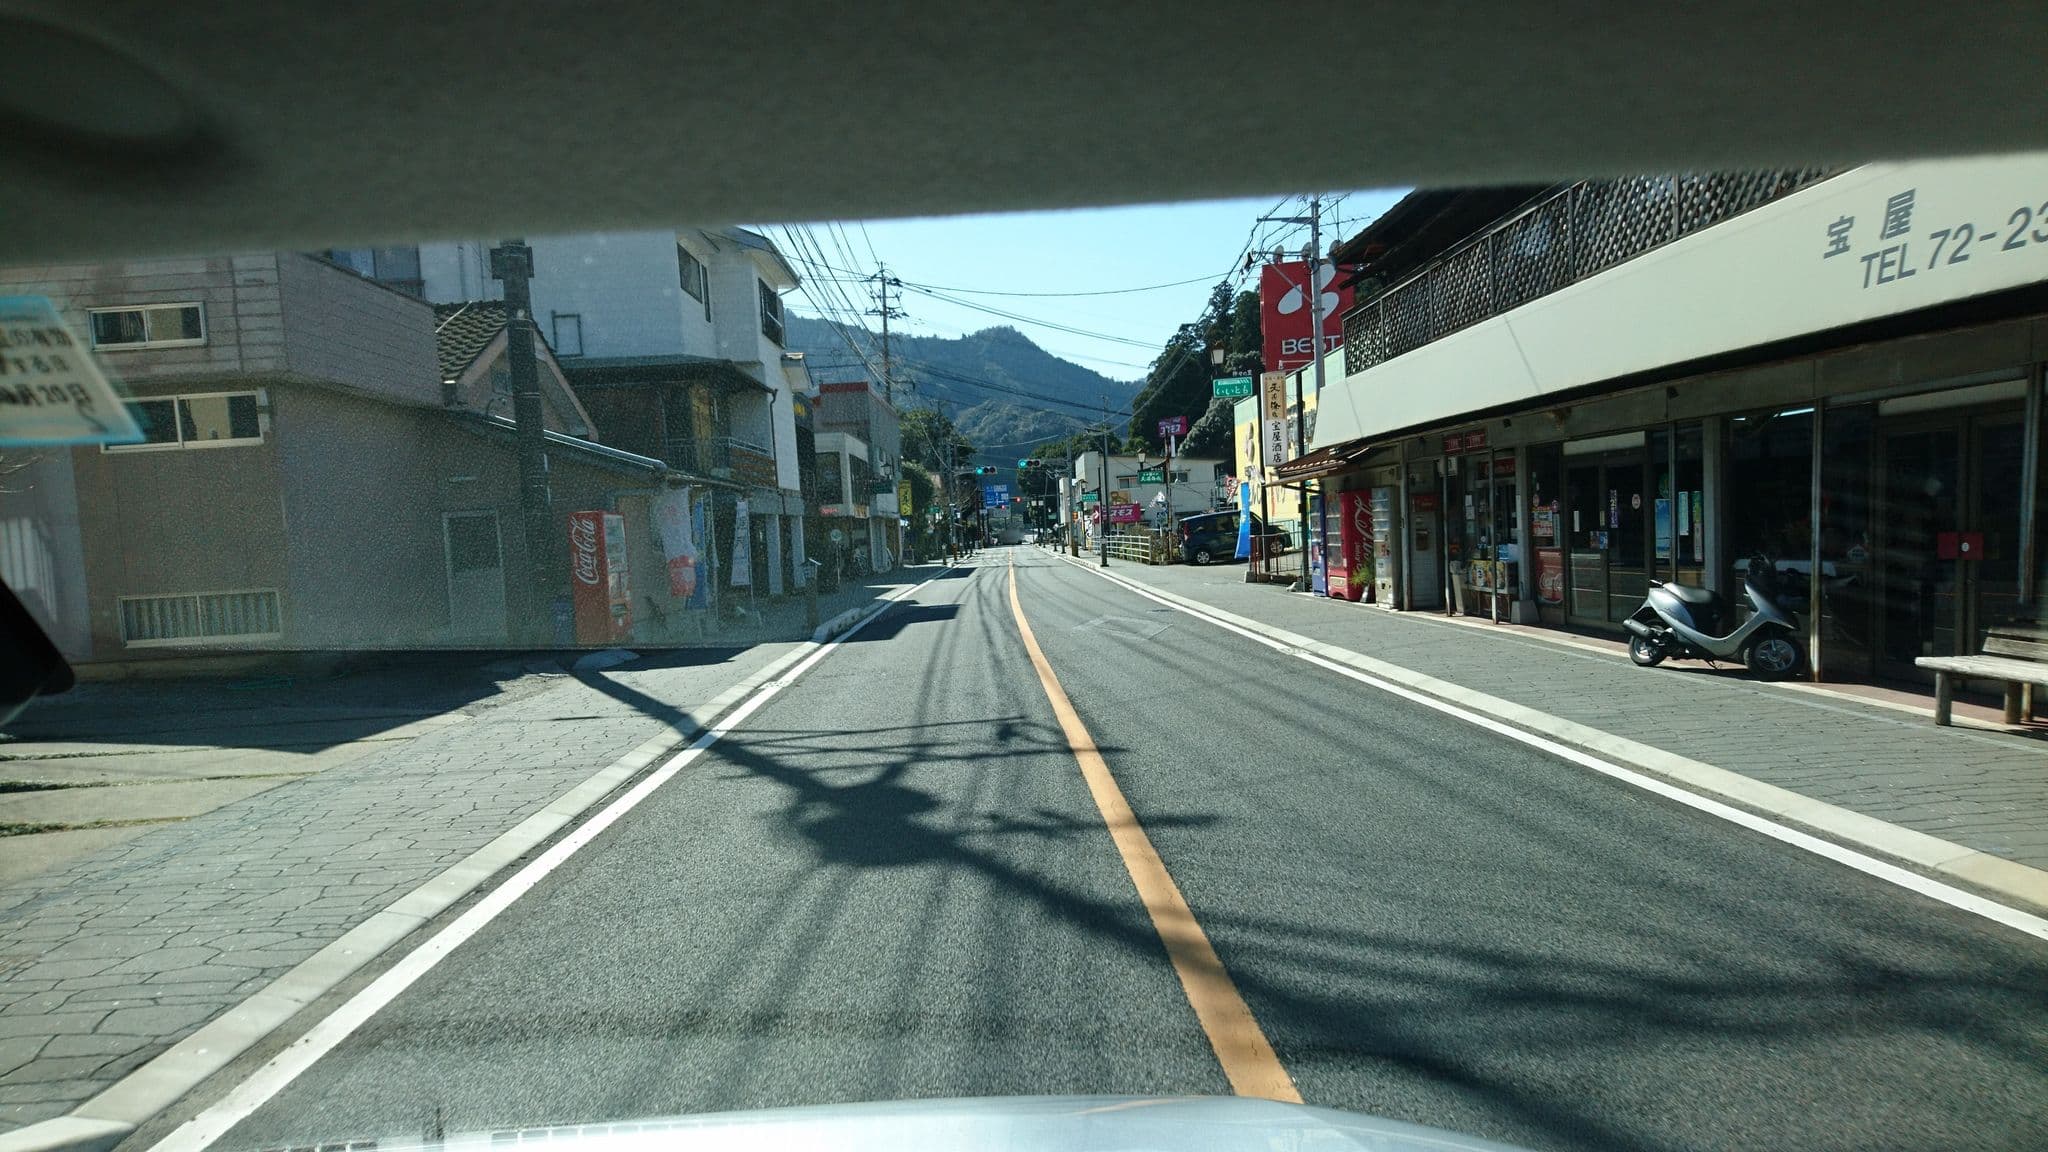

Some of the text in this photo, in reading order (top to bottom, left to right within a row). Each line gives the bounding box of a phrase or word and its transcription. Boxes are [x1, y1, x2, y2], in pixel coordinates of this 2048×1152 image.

[1824, 189, 1916, 259] 宝屋
[1860, 244, 1916, 288] TEL
[1216, 385, 1249, 395] いいとも
[1271, 421, 1283, 463] 宝屋酒店
[571, 515, 599, 584] Coca-Cola
